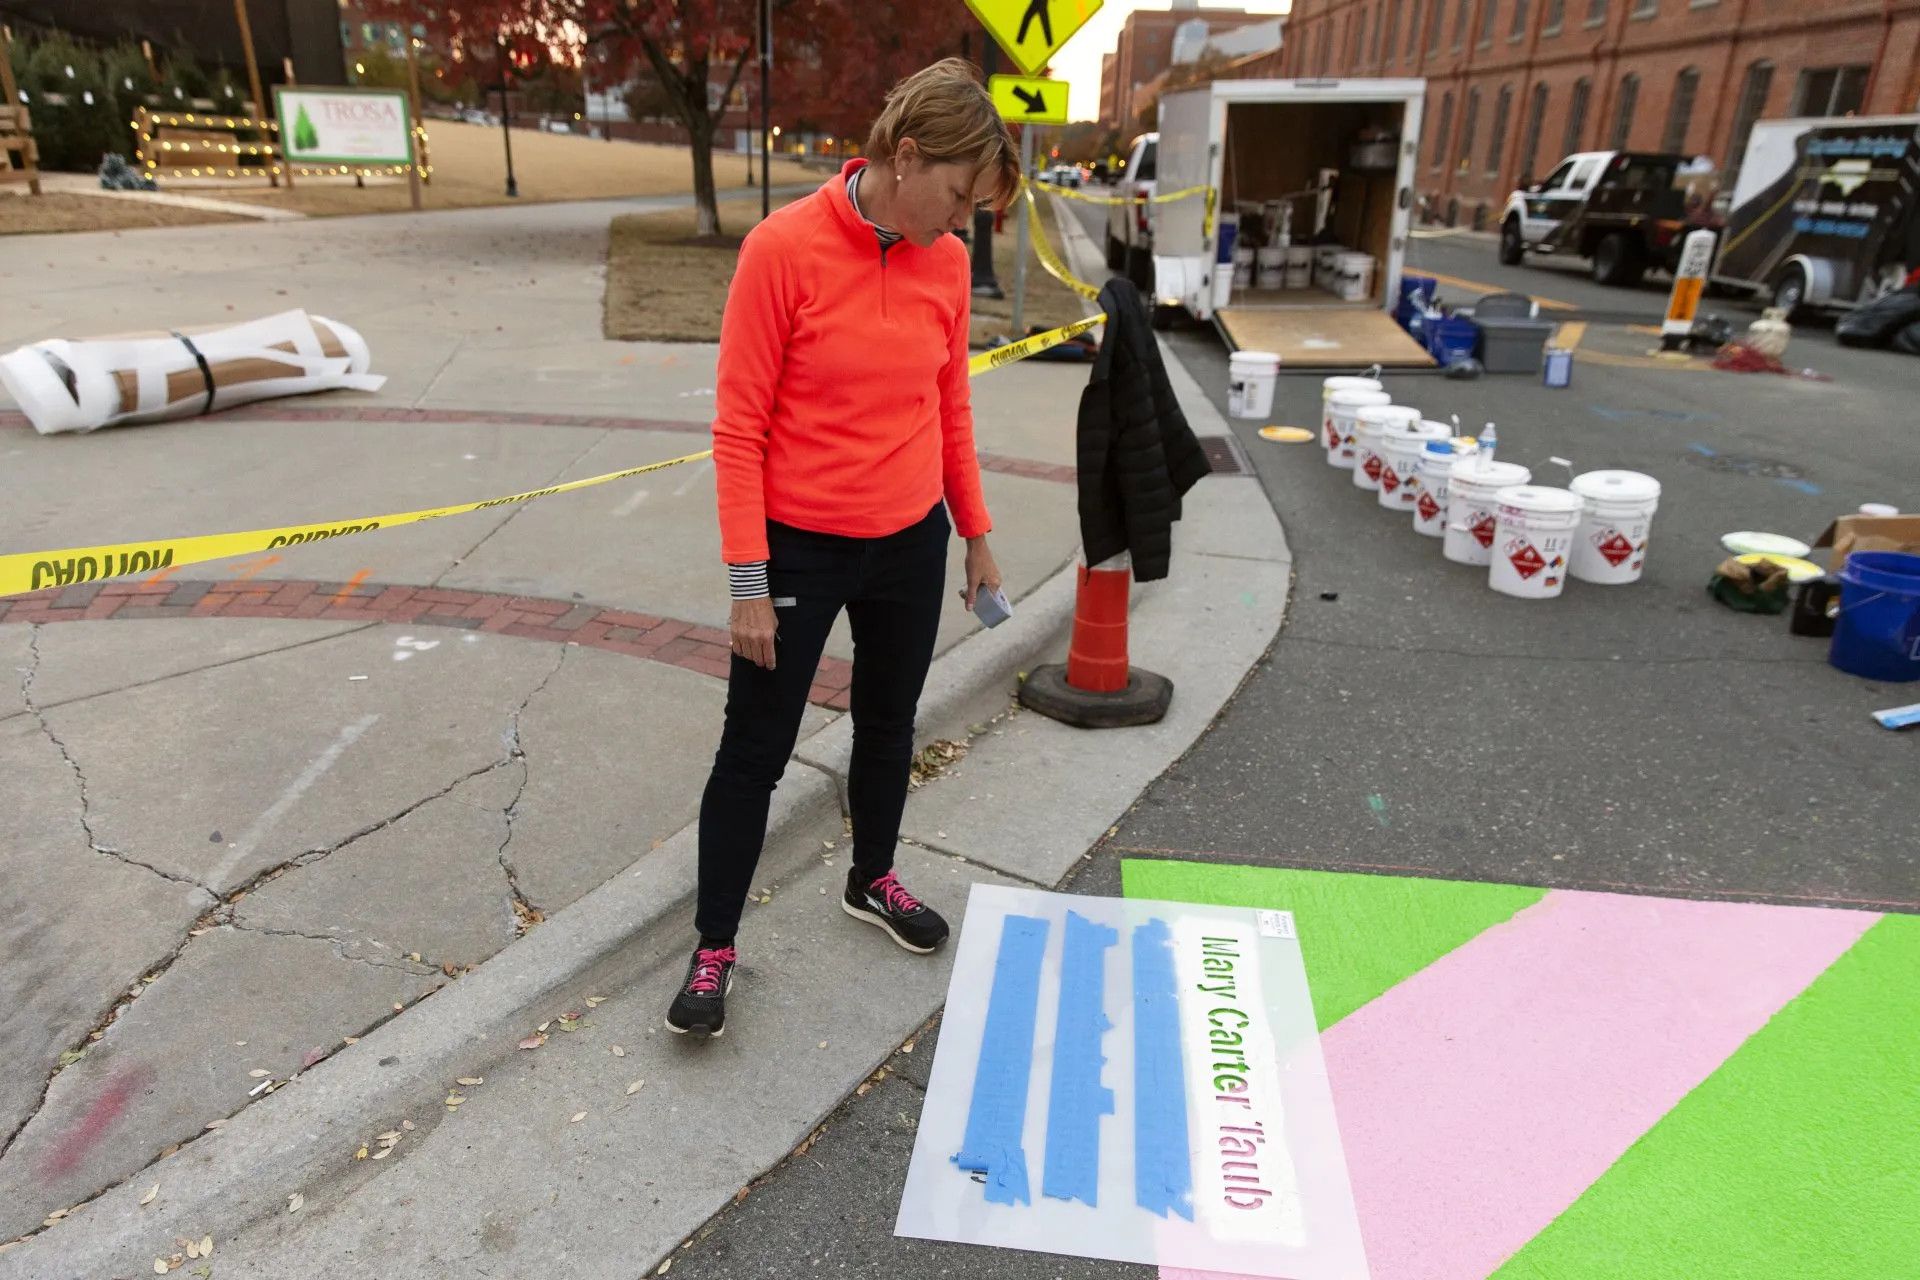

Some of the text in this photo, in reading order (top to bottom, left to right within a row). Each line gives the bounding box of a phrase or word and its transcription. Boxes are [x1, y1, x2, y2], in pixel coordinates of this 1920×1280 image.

[321, 99, 398, 121] TROSA
[1196, 936, 1273, 1211] Mary Carter Taub
